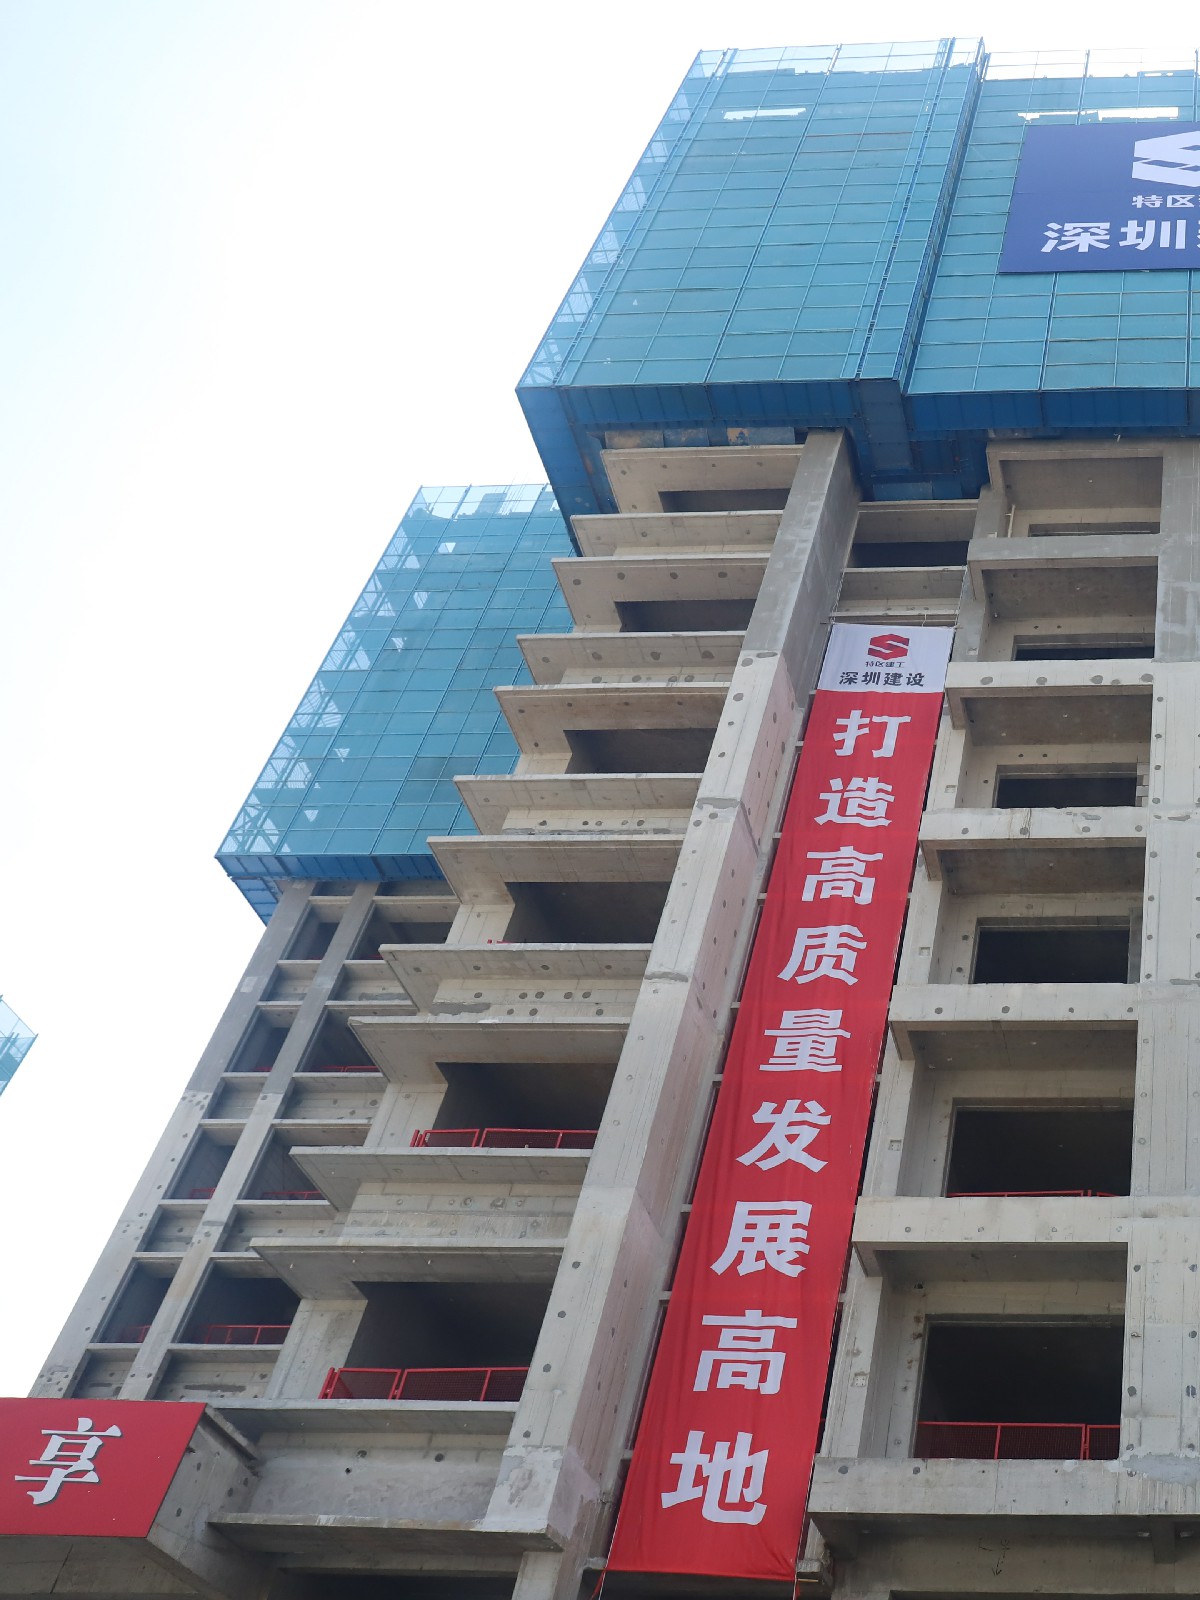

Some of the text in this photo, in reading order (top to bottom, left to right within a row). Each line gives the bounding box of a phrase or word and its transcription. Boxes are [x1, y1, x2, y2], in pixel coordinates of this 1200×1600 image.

[838, 671, 925, 687] 深圳建设
[865, 660, 906, 668] 特区建工
[661, 709, 912, 1526] 打造高质量发展高地
[14, 1417, 122, 1505] 享
